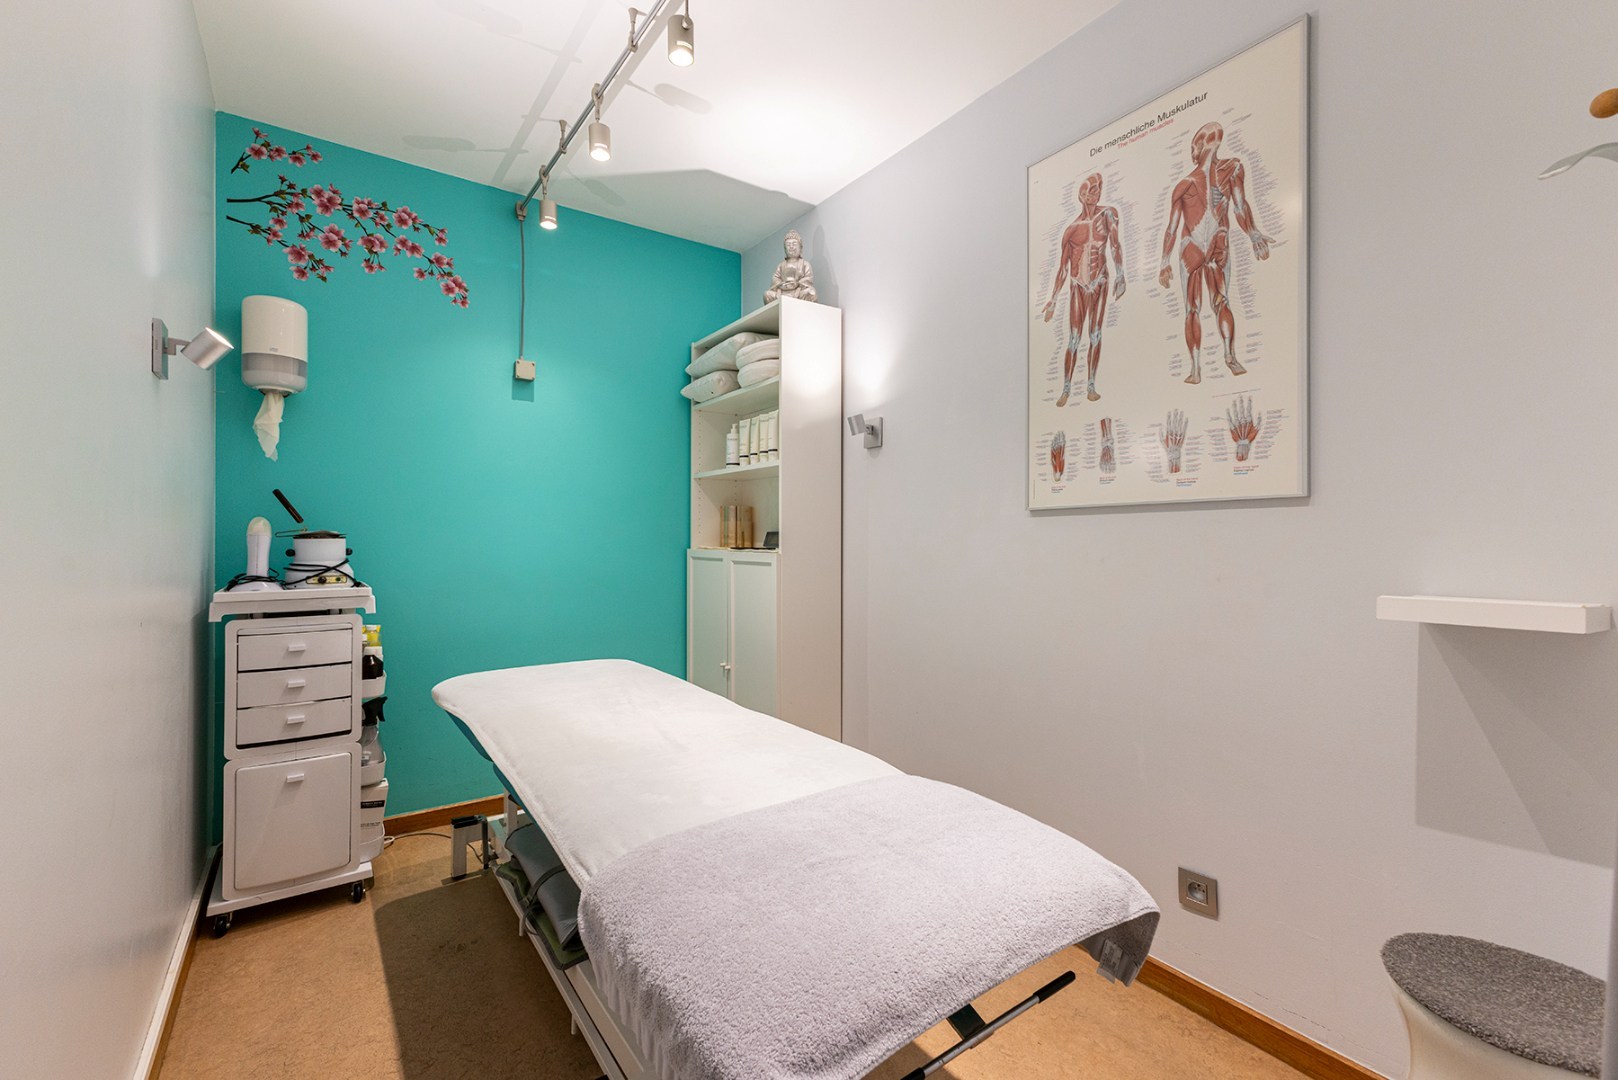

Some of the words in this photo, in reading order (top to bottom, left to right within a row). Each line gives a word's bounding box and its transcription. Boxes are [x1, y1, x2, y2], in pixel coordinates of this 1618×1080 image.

[1089, 146, 1103, 157] Die
[1104, 119, 1155, 150] menschliche
[1157, 92, 1208, 123] Muskulatur
[1117, 141, 1128, 149] The
[1129, 131, 1148, 143] human
[1149, 118, 1174, 133] muscles
